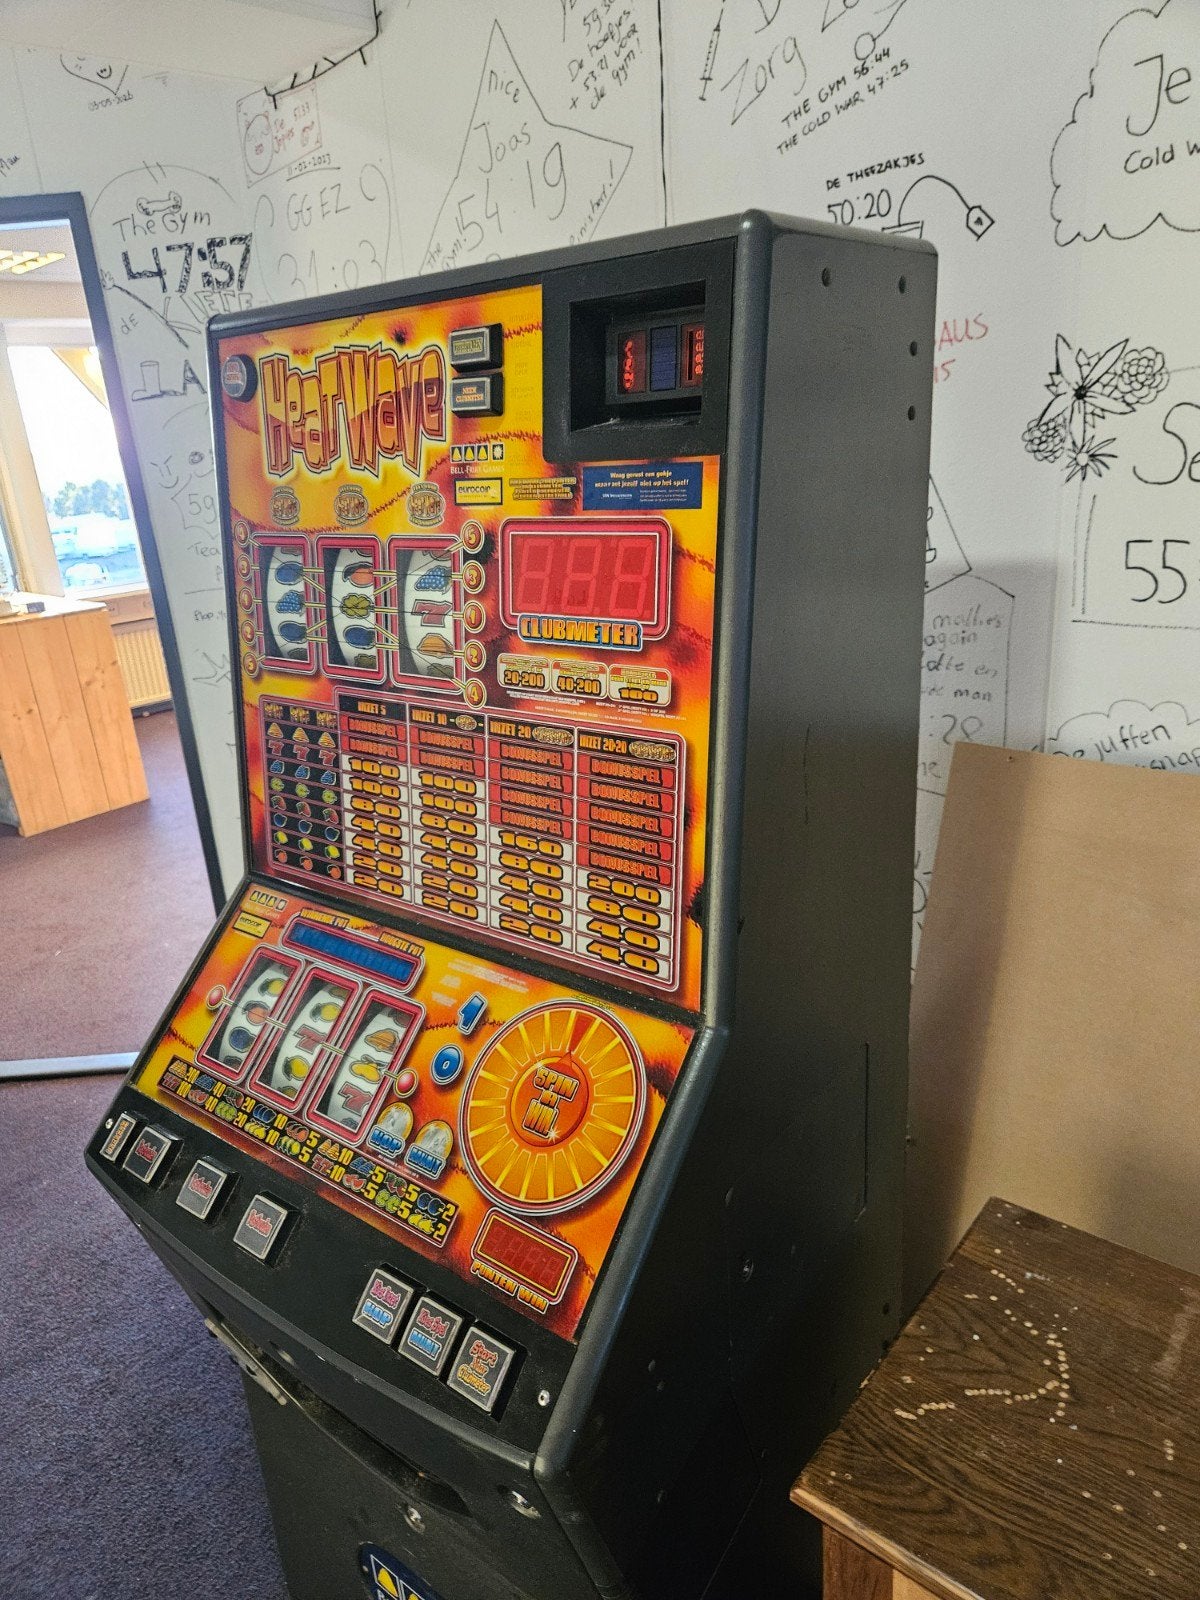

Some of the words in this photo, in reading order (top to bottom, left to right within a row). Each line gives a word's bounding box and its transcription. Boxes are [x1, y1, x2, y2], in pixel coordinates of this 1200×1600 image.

[719, 36, 807, 126] Zorg
[777, 134, 798, 155] THE
[802, 111, 831, 137] COLD
[835, 91, 864, 115] WAR
[867, 59, 910, 94] 47:25
[781, 98, 811, 128] THE
[818, 76, 847, 104] GYM
[474, 122, 531, 174] Joas
[1124, 143, 1174, 173] Cold
[826, 178, 841, 191] DE
[847, 153, 925, 183] THEEZAKJES
[287, 194, 312, 231] GG
[827, 189, 892, 226] 50:20
[113, 213, 156, 242] The
[161, 211, 211, 236] Gym
[121, 232, 253, 294] 47:57
[520, 617, 639, 646] CLUBMETER
[518, 725, 531, 739] 20
[579, 733, 601, 749] INZET
[349, 757, 400, 779] 100
[349, 776, 400, 799] 100
[419, 771, 476, 796] 100
[350, 795, 401, 819] 80
[419, 791, 477, 817] 100
[351, 814, 402, 838] 40
[420, 812, 477, 837] 80
[352, 834, 403, 858] 40
[421, 832, 478, 858] 40
[499, 830, 563, 858] 160
[353, 852, 403, 878] 20
[421, 852, 478, 878] 40
[499, 851, 564, 880] 80
[353, 871, 403, 897] 20
[421, 871, 478, 898] 20
[499, 872, 564, 901] 40
[587, 873, 662, 905] 200
[422, 891, 478, 919] 20
[499, 894, 564, 924] 40
[587, 896, 661, 929] 80
[499, 916, 564, 945] 20
[587, 918, 660, 952] 40
[586, 940, 659, 974] 40
[535, 1067, 578, 1099] SPIN
[523, 1100, 557, 1136] WIN
[306, 1130, 321, 1148] 5
[298, 1146, 313, 1163] 5
[472, 1260, 517, 1294] PUNTEN
[519, 1286, 548, 1313] WIN
[470, 1340, 498, 1367] Start
